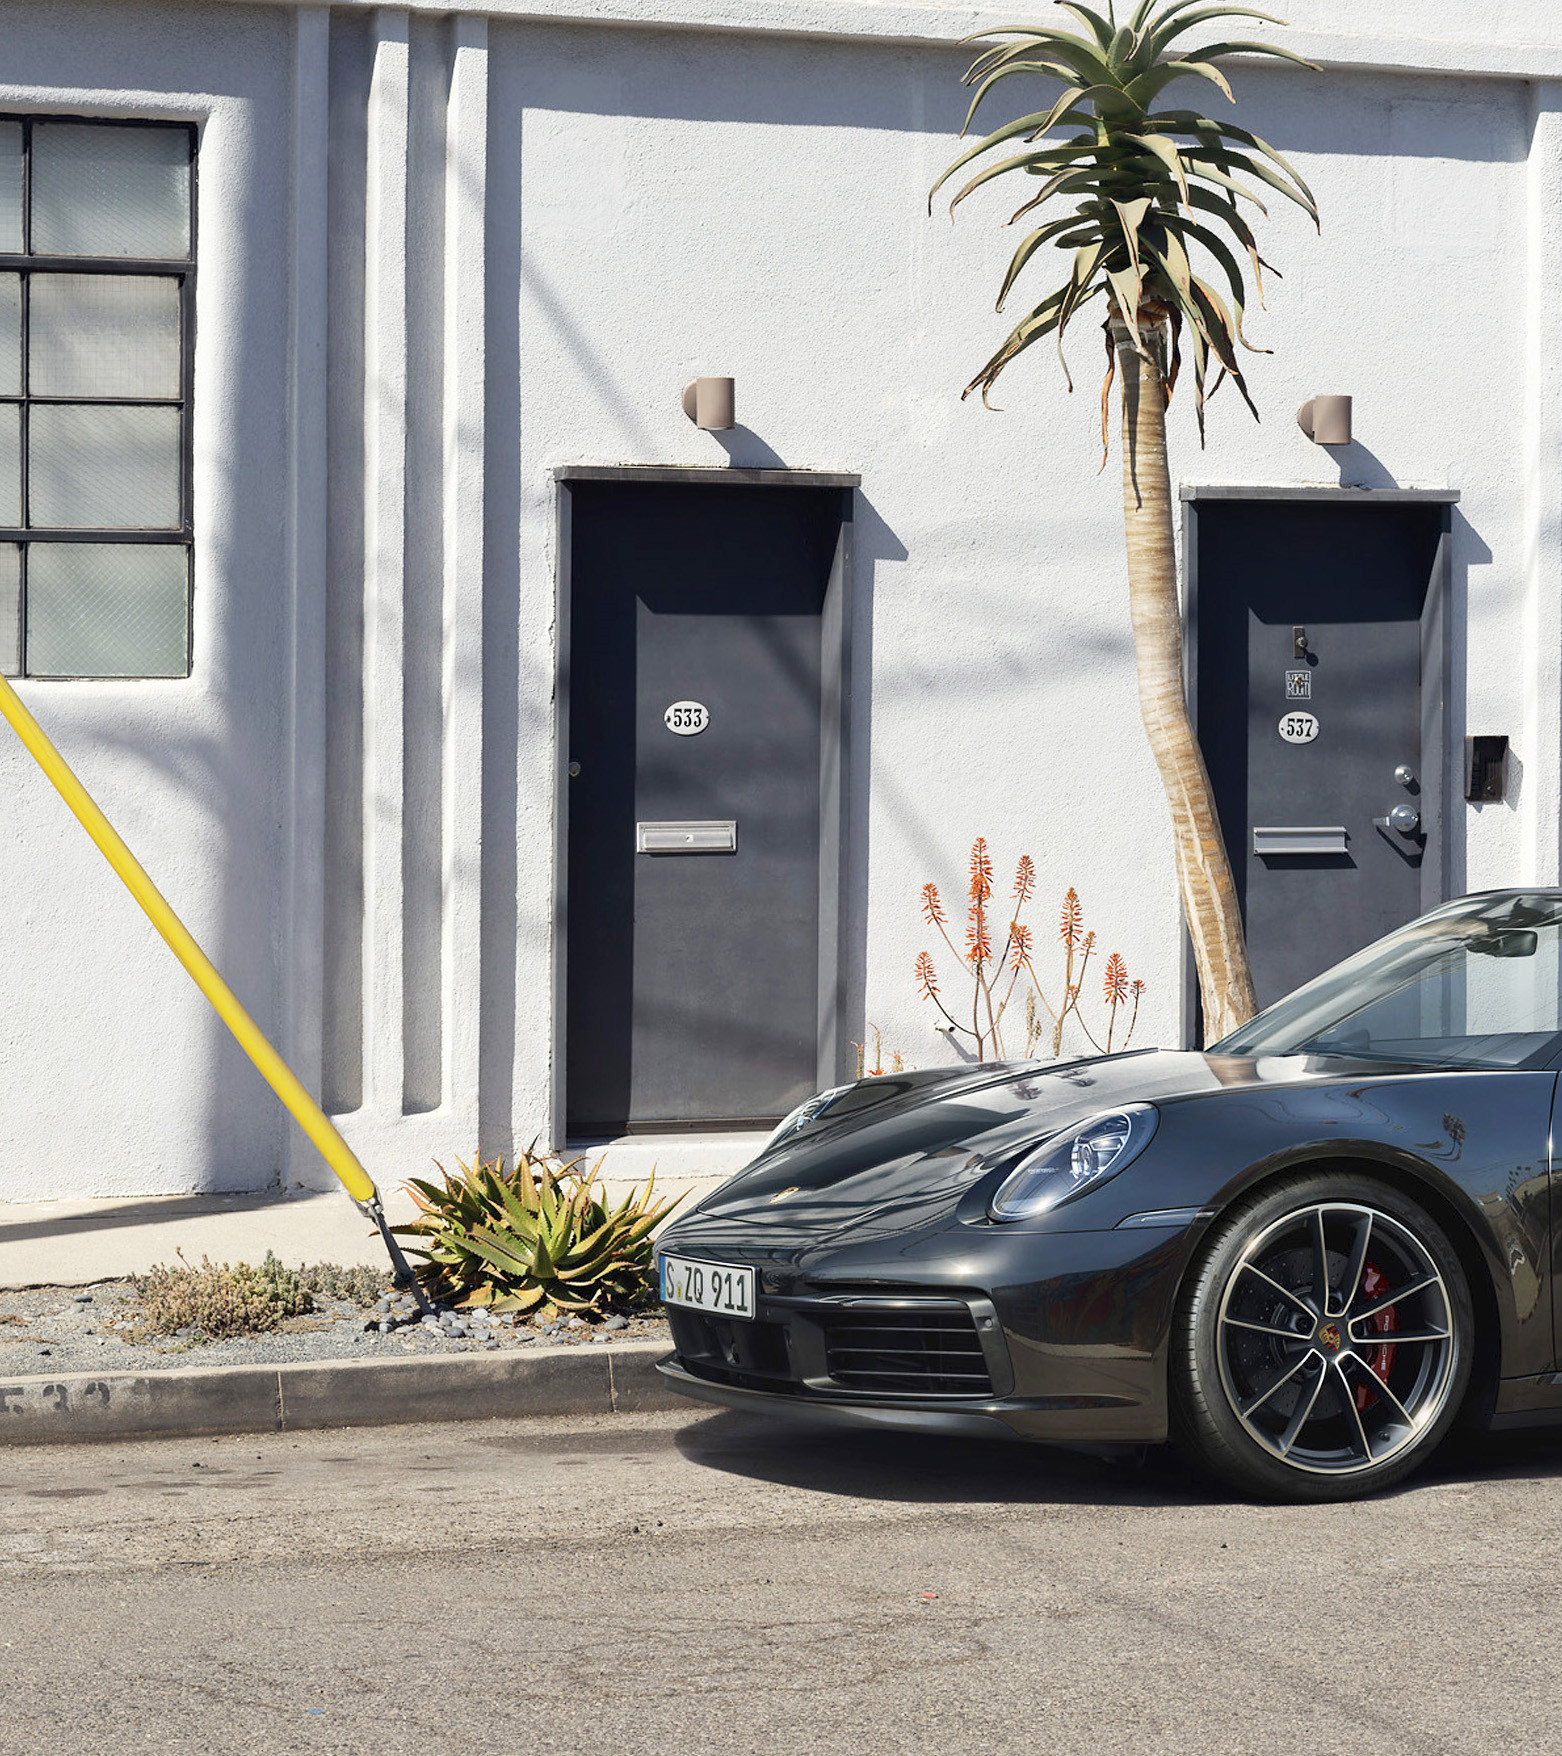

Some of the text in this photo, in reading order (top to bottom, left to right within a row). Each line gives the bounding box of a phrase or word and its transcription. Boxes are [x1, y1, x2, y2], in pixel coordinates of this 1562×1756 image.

[673, 708, 702, 727] 533
[1287, 718, 1313, 737] 537
[666, 1261, 748, 1312] S ZQ 911
[1380, 1314, 1390, 1371] POCHE
